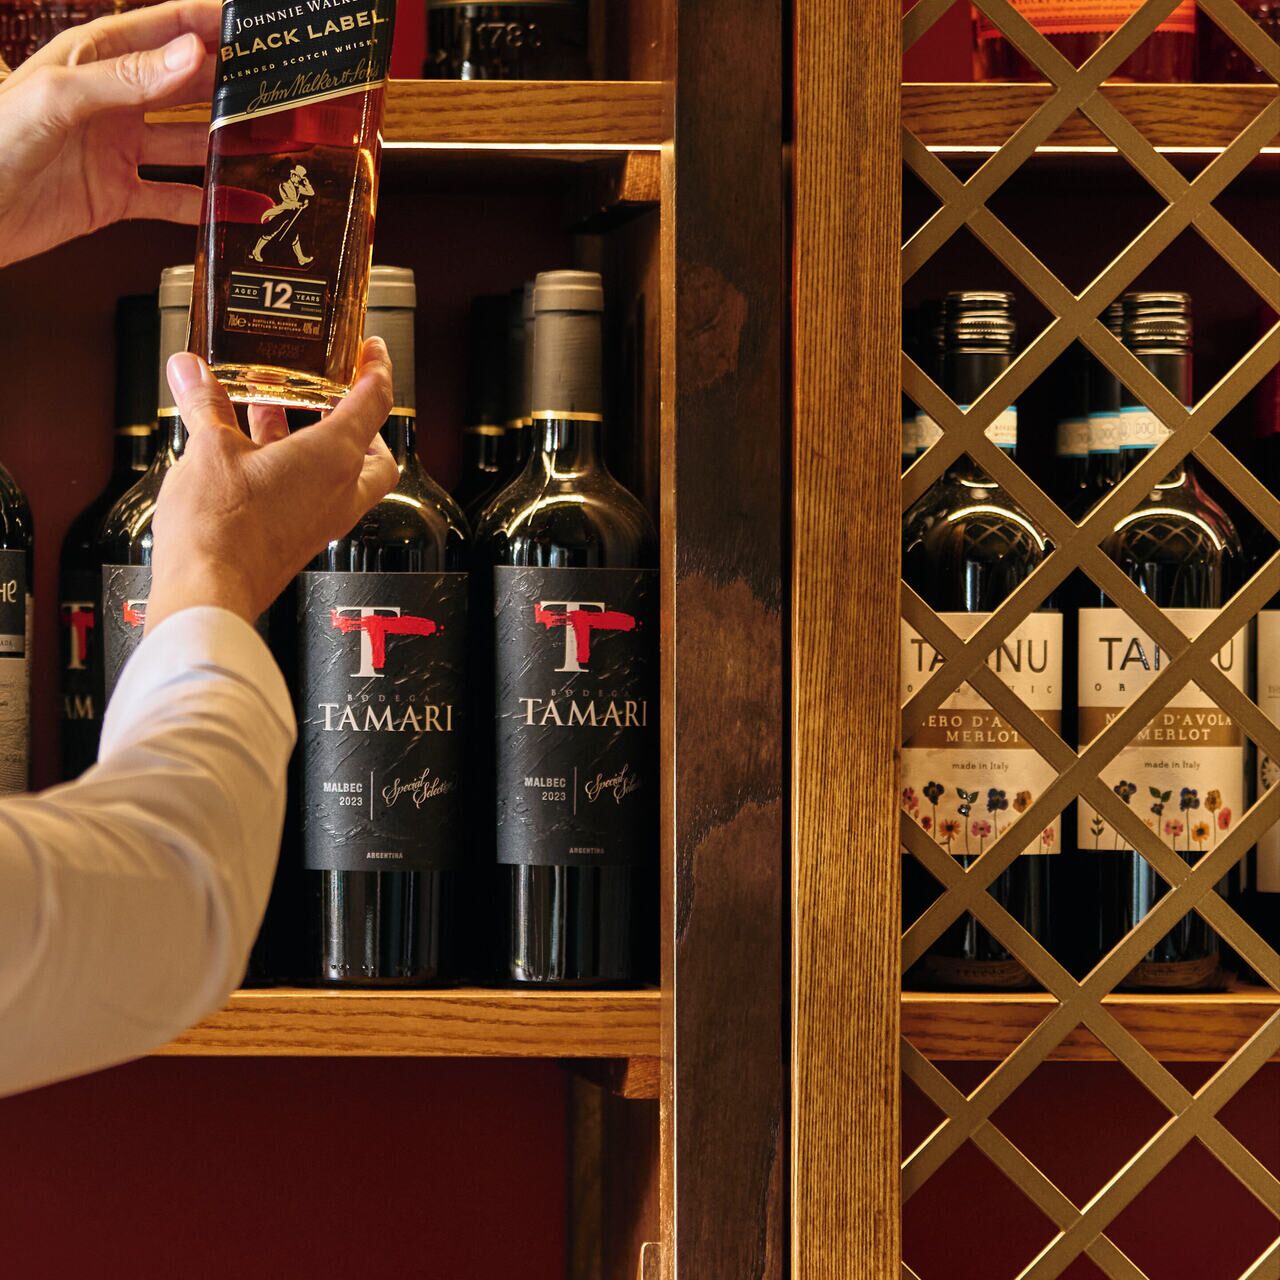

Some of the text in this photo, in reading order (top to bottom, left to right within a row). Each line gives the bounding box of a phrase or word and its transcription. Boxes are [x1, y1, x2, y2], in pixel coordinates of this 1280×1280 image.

[235, 5, 304, 34] JOHNNIE
[220, 8, 385, 63] BLACK LABEL
[223, 38, 378, 82] BLENDED SCOTCH WHISKY
[246, 68, 342, 113] John Walker
[234, 287, 258, 296] AGED
[261, 280, 293, 310] 12
[295, 294, 320, 302] YEARS
[346, 694, 431, 702] BODEGA
[318, 702, 453, 732] TAMARI
[518, 697, 647, 728] TAMARI
[922, 715, 963, 728] ERO
[946, 730, 1020, 743] MERLOT
[1137, 728, 1211, 741] MERLOT
[952, 762, 1009, 771] made in Italy
[1144, 761, 1200, 770] made in Italy
[323, 767, 431, 808] MALBEC Special
[524, 776, 567, 788] MALBEC
[584, 763, 629, 803] Special
[339, 796, 364, 807] 2023
[541, 791, 567, 801] 2023
[366, 851, 404, 860] ARGENTINA
[569, 846, 605, 854] ARGENTINA
